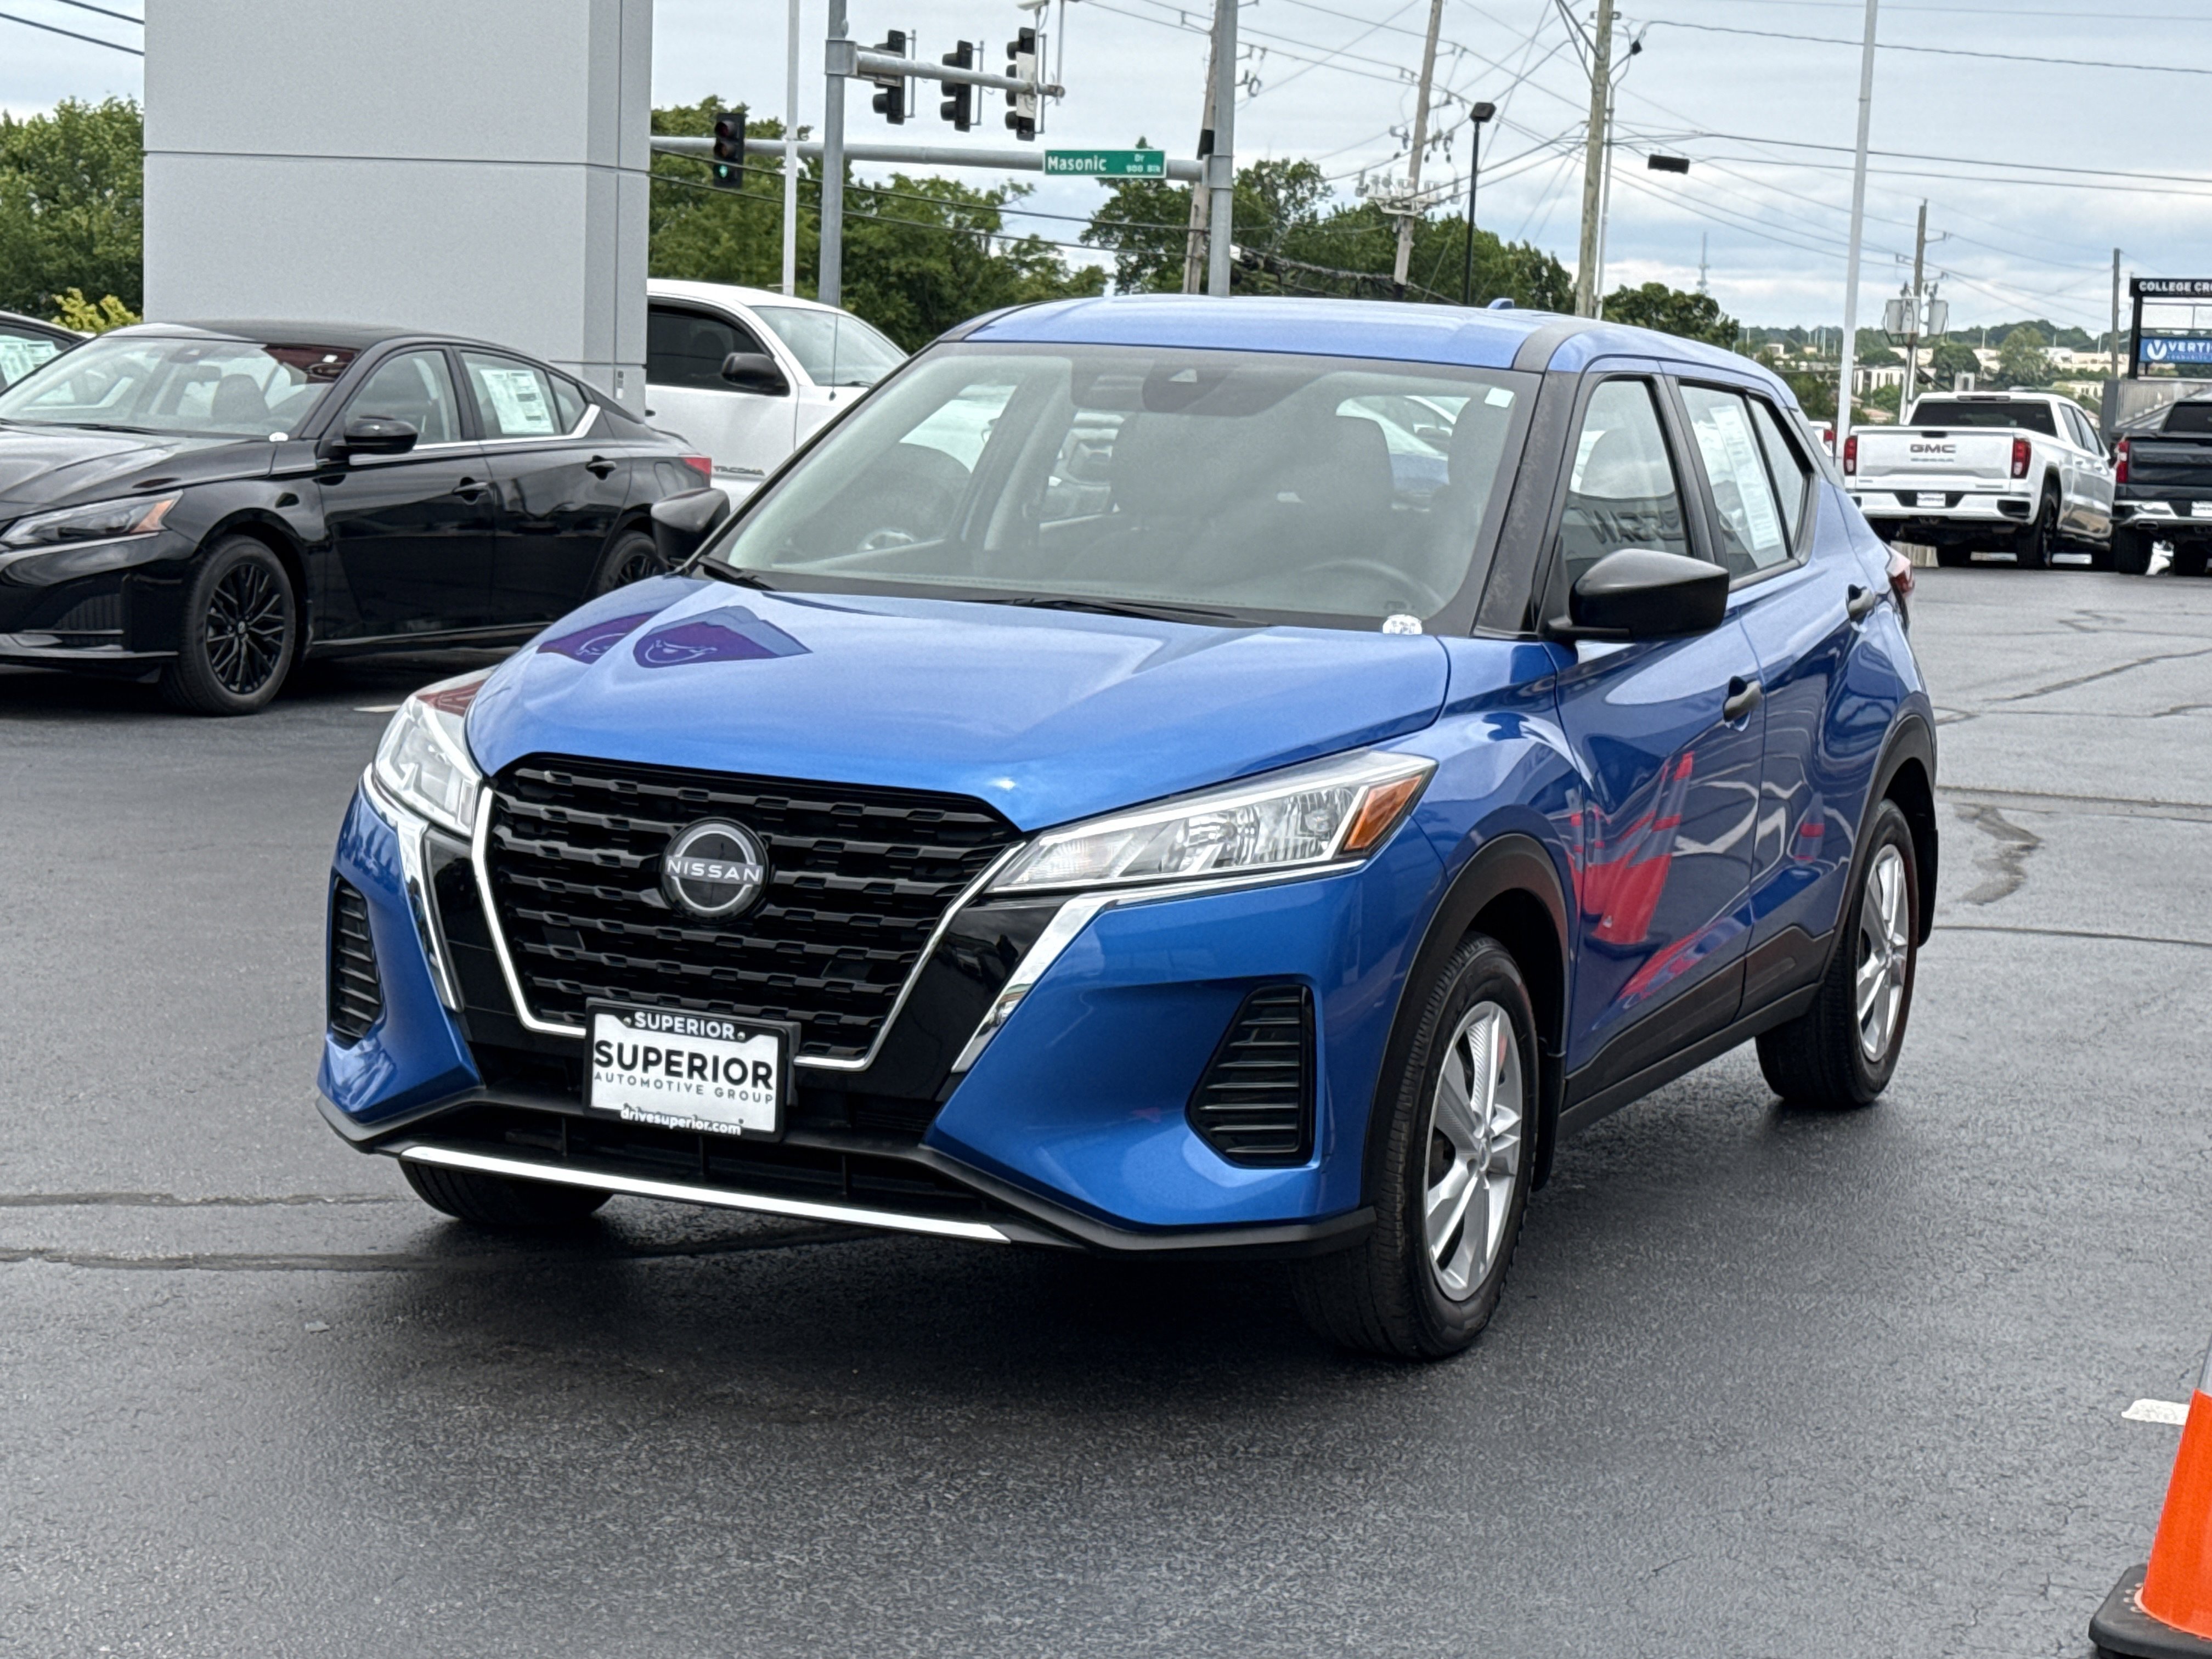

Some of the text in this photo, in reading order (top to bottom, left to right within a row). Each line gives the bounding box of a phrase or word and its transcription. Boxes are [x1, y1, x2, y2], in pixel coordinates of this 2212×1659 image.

[1047, 154, 1107, 172] Masonic
[1134, 154, 1145, 162] Dr
[2138, 280, 2212, 293] COLLEGE CR
[2168, 340, 2212, 354] VERTI
[1910, 443, 1956, 454] GMC
[667, 859, 760, 882] NISSAN
[634, 1011, 735, 1040] SUPERIOR
[594, 1039, 774, 1091] SUPERIOR
[594, 1071, 774, 1104] AUTOMOTIVE GROUP
[620, 1102, 742, 1136] drivesuperior.com
